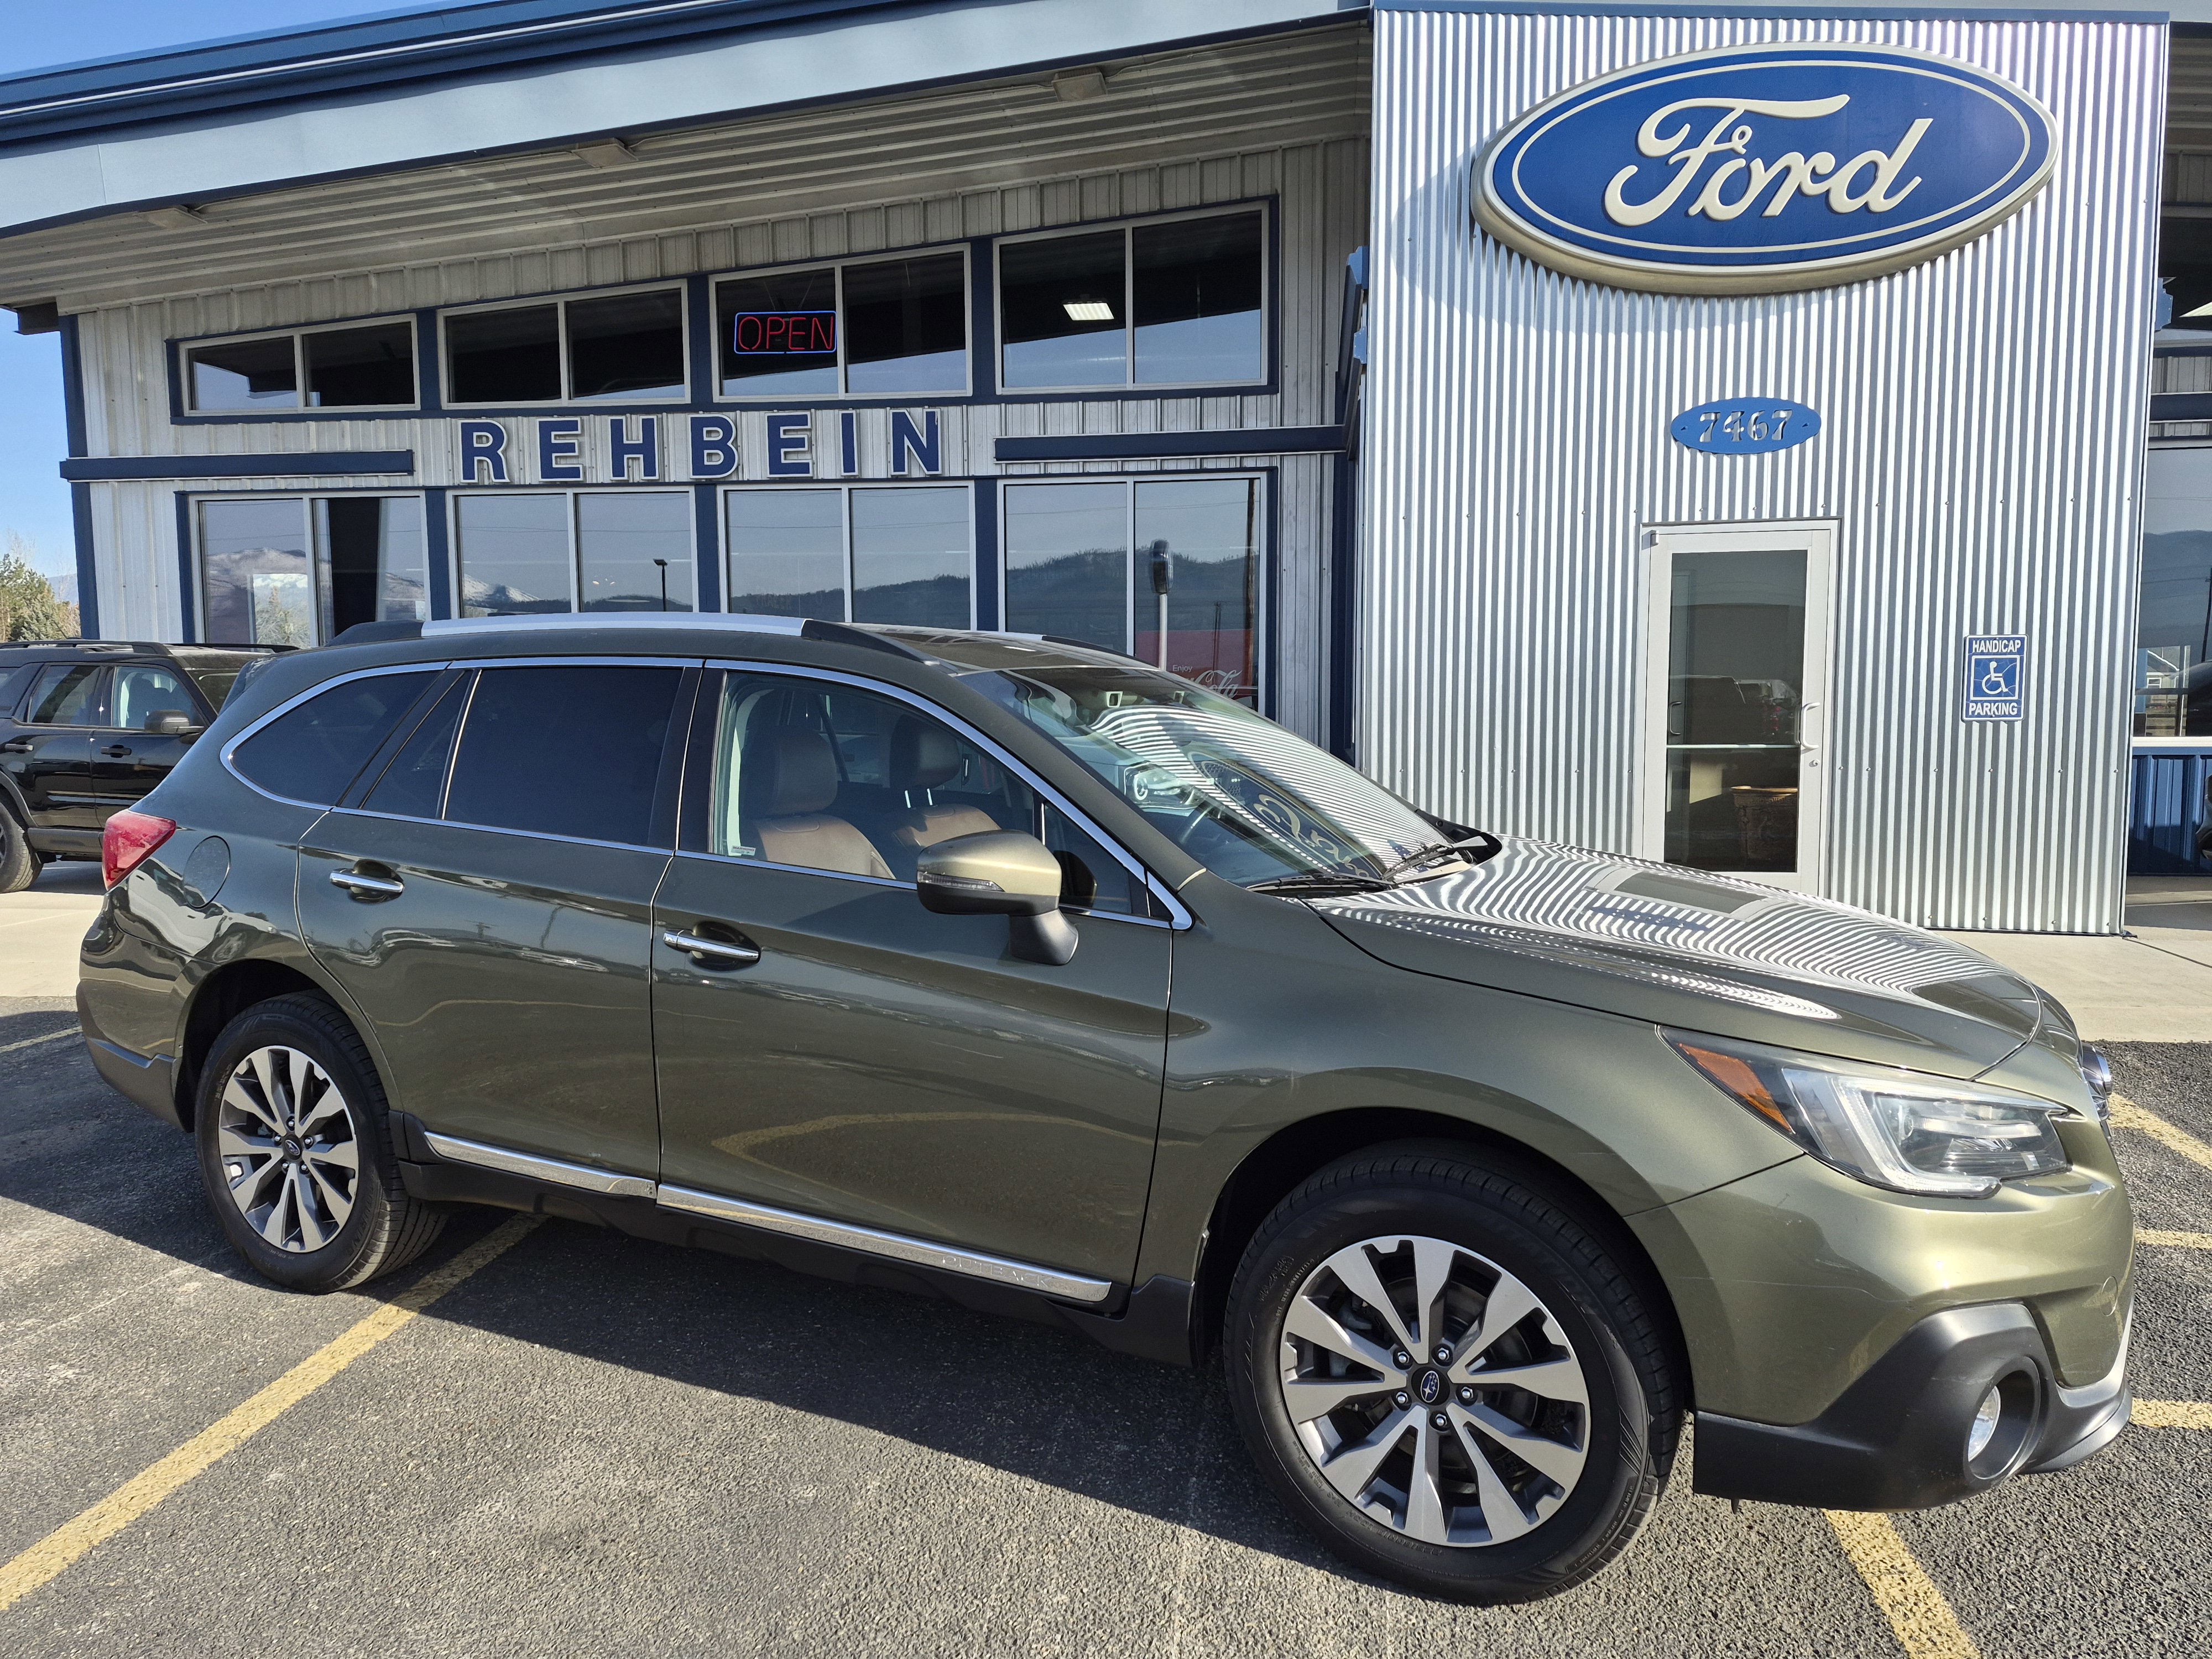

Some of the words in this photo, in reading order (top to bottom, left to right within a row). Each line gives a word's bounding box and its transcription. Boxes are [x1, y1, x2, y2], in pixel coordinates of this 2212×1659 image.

[1604, 93, 1933, 226] Ford
[737, 315, 834, 351] OPEN
[1699, 409, 1793, 442] 7467
[458, 408, 942, 483] REHBEIN
[1972, 639, 2022, 653] HANDICAP
[1172, 664, 1193, 673] Enjoy
[1968, 702, 2018, 716] PARKING
